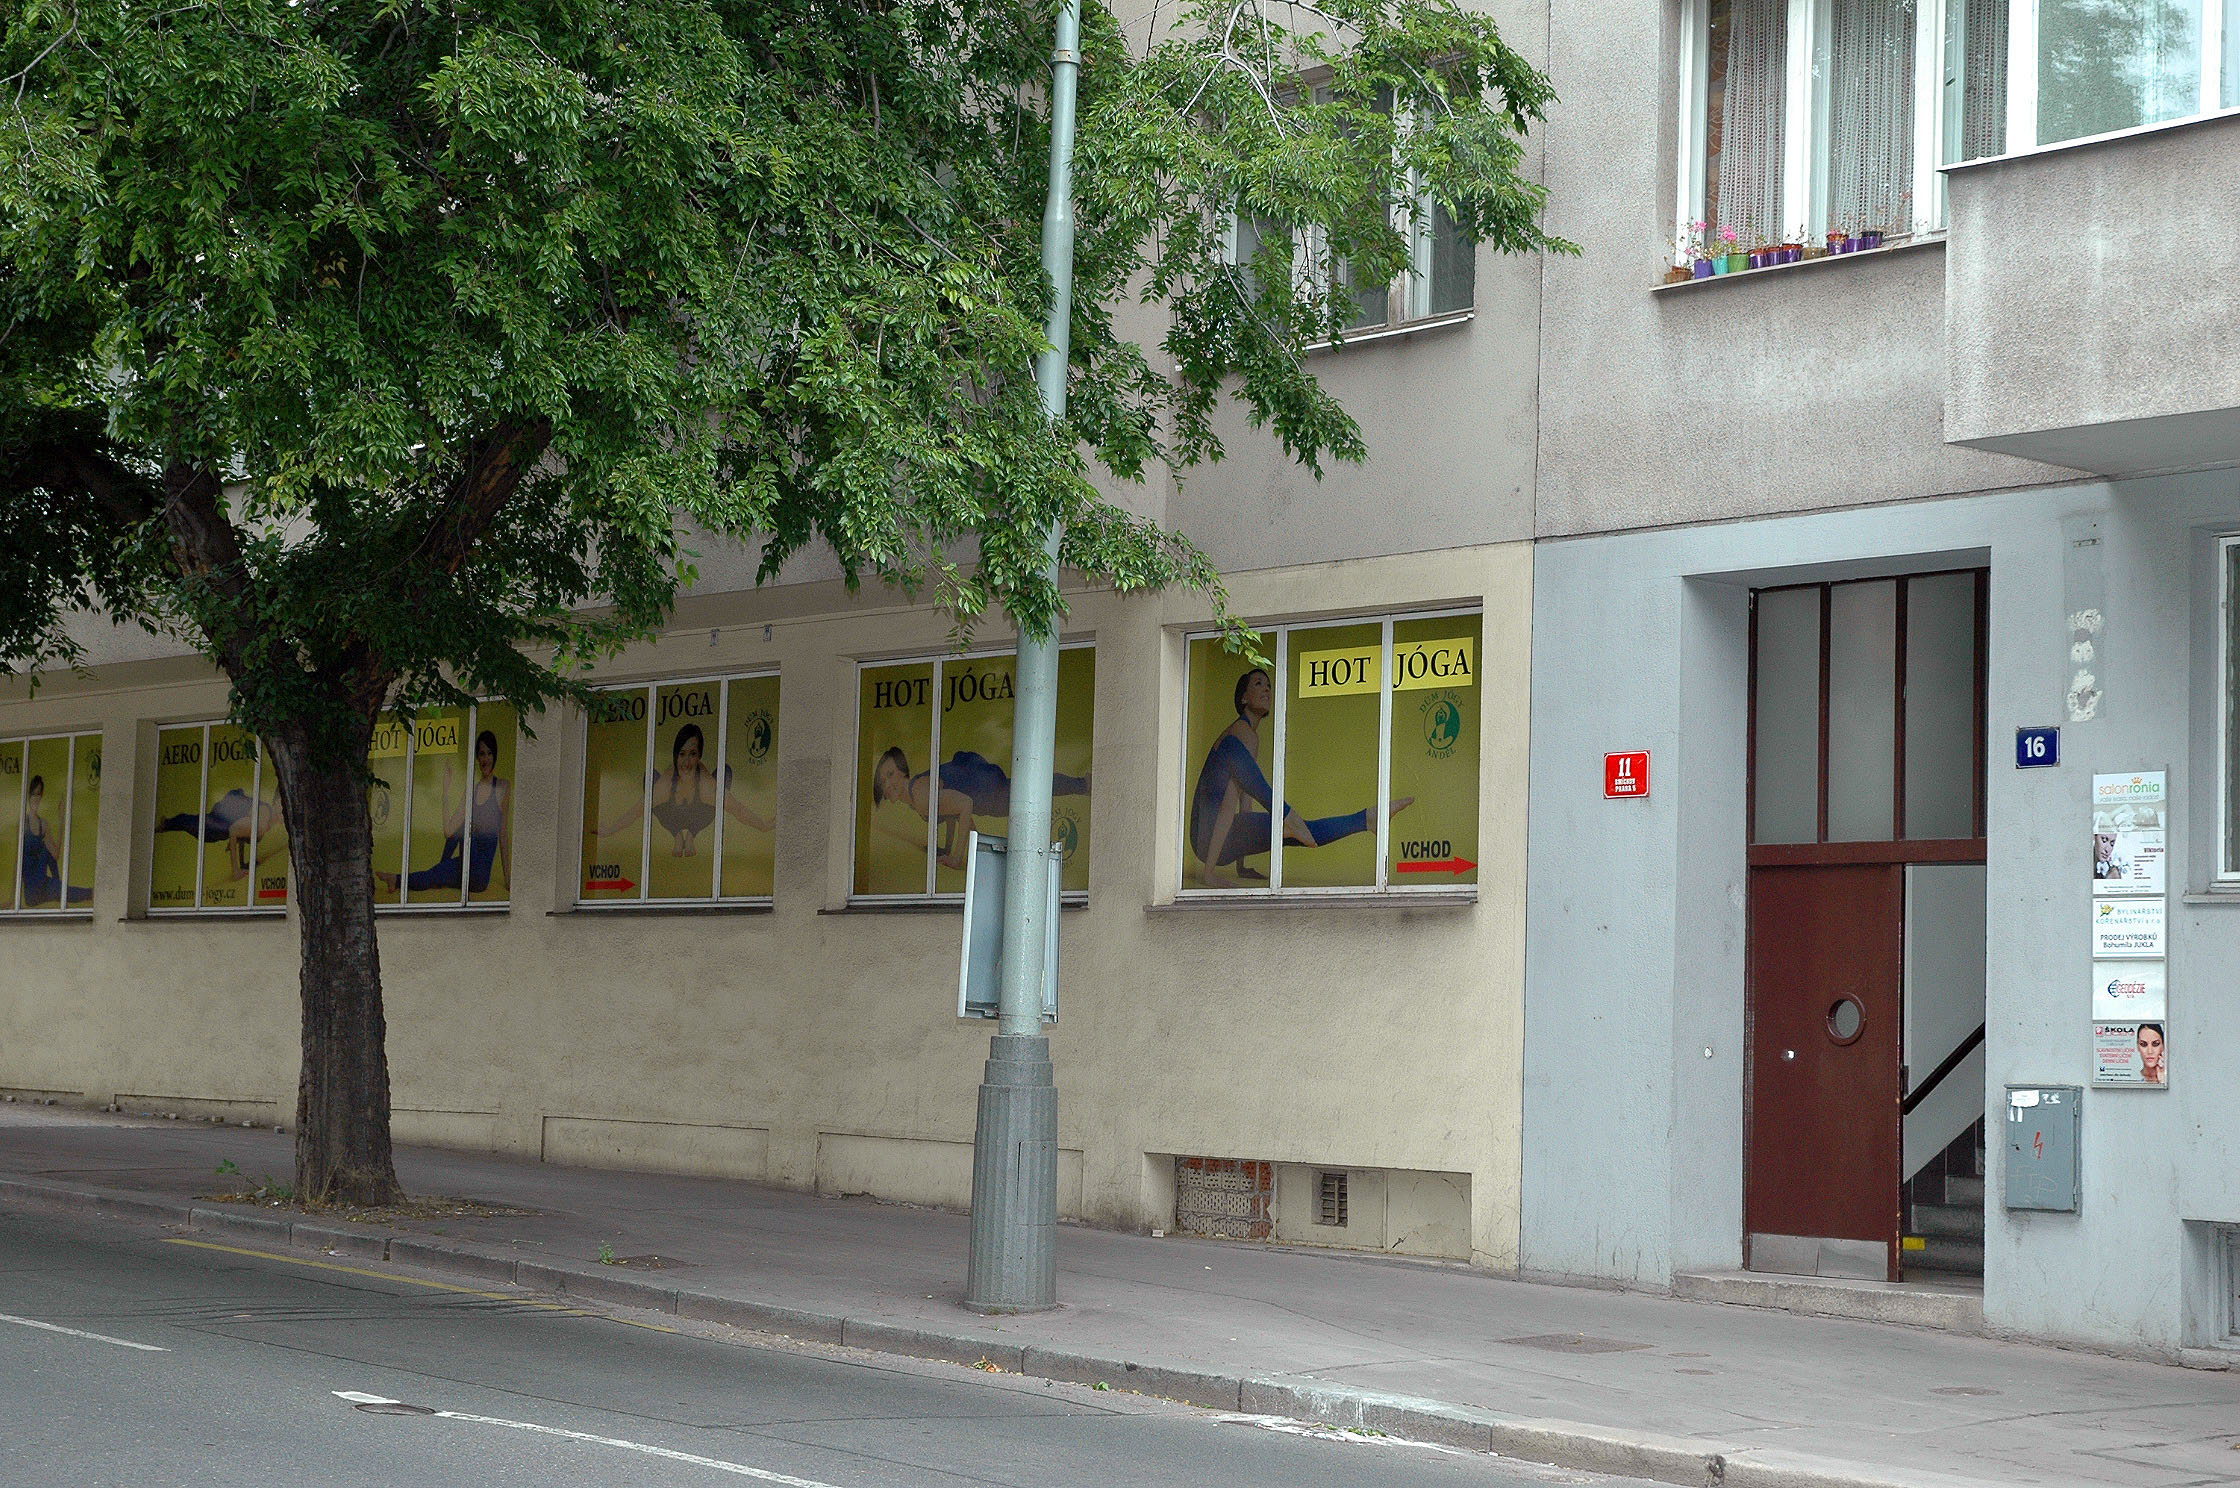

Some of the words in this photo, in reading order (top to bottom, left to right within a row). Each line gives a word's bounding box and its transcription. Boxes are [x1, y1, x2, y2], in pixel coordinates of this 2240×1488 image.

[1309, 657, 1371, 687] HOT
[1393, 644, 1471, 689] JÓGA
[874, 678, 930, 708] HOT
[945, 667, 1015, 712] JÓGA
[658, 688, 713, 726] JÓGA
[369, 730, 400, 751] HOT
[415, 722, 457, 753] JÓGA
[2025, 736, 2045, 758] 16
[161, 743, 201, 765] AERO
[211, 736, 253, 768] JÓG
[1618, 757, 1631, 777] 11
[1401, 840, 1451, 859] VCHOD
[261, 877, 286, 890] VCHOD
[589, 864, 621, 879] VCHOD
